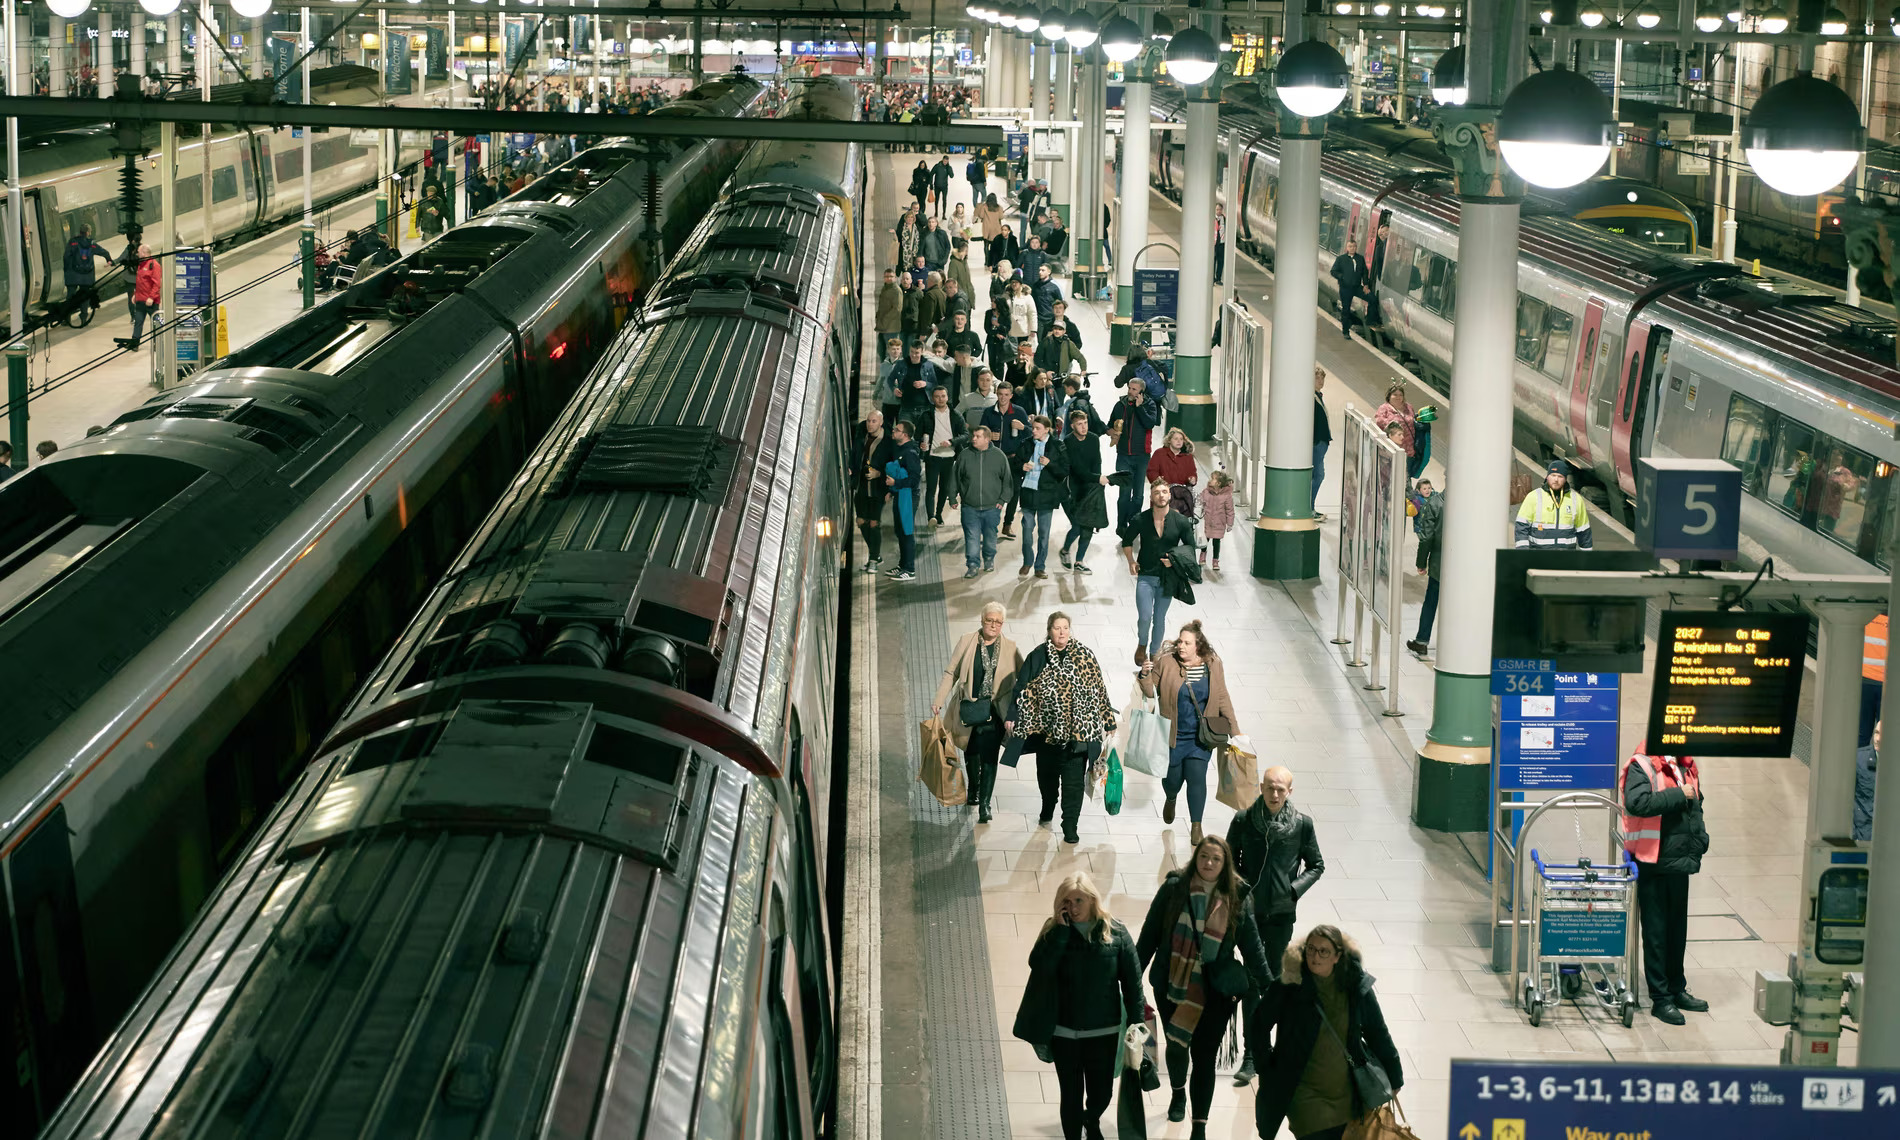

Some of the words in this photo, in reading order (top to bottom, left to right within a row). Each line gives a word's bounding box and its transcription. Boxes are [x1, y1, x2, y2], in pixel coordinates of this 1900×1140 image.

[233, 36, 240, 44] 8
[430, 32, 438, 69] Welcome
[615, 44, 622, 52] 6
[391, 39, 400, 82] Welcome
[964, 51, 971, 60] 5
[1374, 62, 1380, 70] 2
[1641, 477, 1652, 528] 5
[1682, 484, 1717, 535] 5
[1675, 627, 1703, 640] 20:27
[1736, 629, 1749, 641] On
[1751, 629, 1771, 641] time
[1673, 641, 1722, 654] Birmingham
[1724, 642, 1743, 653] New
[1745, 643, 1757, 654] St
[1498, 660, 1536, 670] GSM-R
[1672, 656, 1692, 666] Calling
[1754, 657, 1769, 668] Page
[1769, 658, 1775, 667] 2
[1775, 658, 1783, 667] of
[1784, 658, 1790, 667] 2
[1505, 674, 1544, 693] 364
[1686, 725, 1727, 735] CrossCountry
[1728, 726, 1750, 734] service
[1751, 726, 1772, 735] formed
[1620, 1078, 1652, 1102] 13
[1680, 1079, 1700, 1104] &
[1708, 1080, 1741, 1105] 14
[1750, 1080, 1769, 1093] via
[1750, 1092, 1785, 1105] stairs
